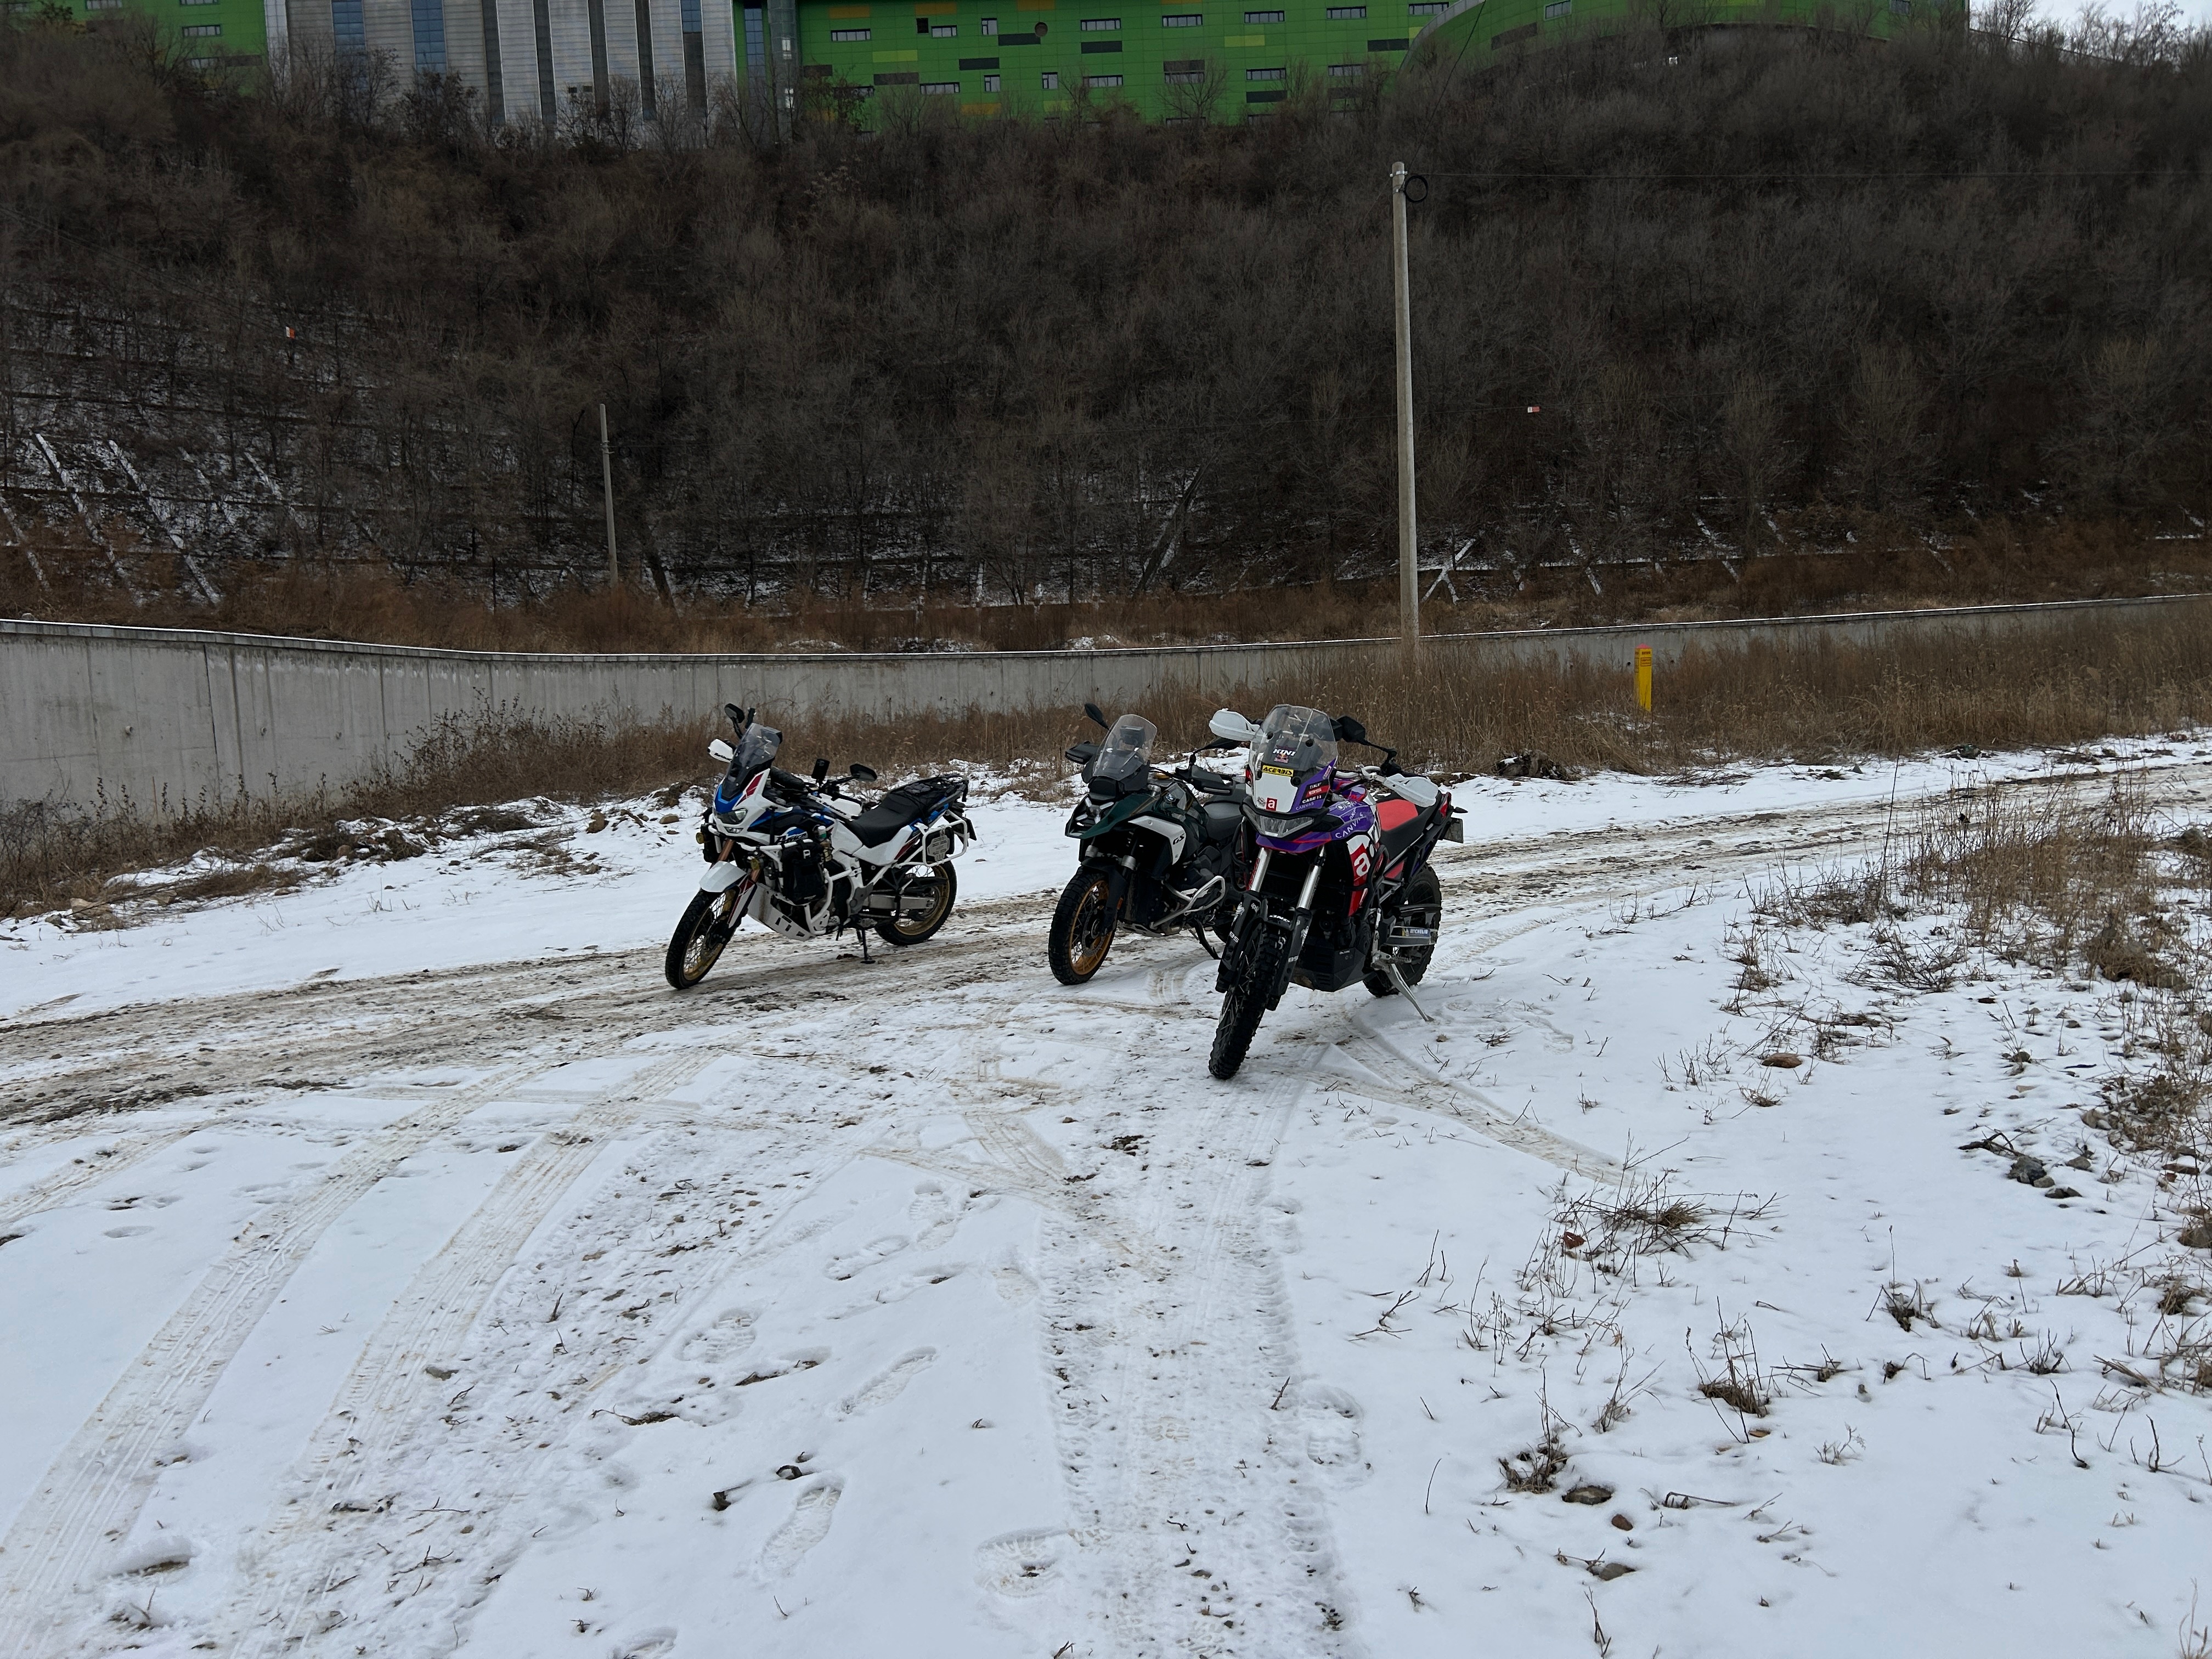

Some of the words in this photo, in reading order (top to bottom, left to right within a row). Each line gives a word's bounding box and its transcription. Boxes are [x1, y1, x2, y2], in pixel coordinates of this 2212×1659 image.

[1273, 748, 1296, 757] KINI
[1262, 766, 1293, 775] ACERBIS
[1267, 799, 1276, 809] a
[1295, 802, 1314, 810] CANVAS
[1335, 812, 1363, 839] CANVAS
[1172, 833, 1186, 845] GS
